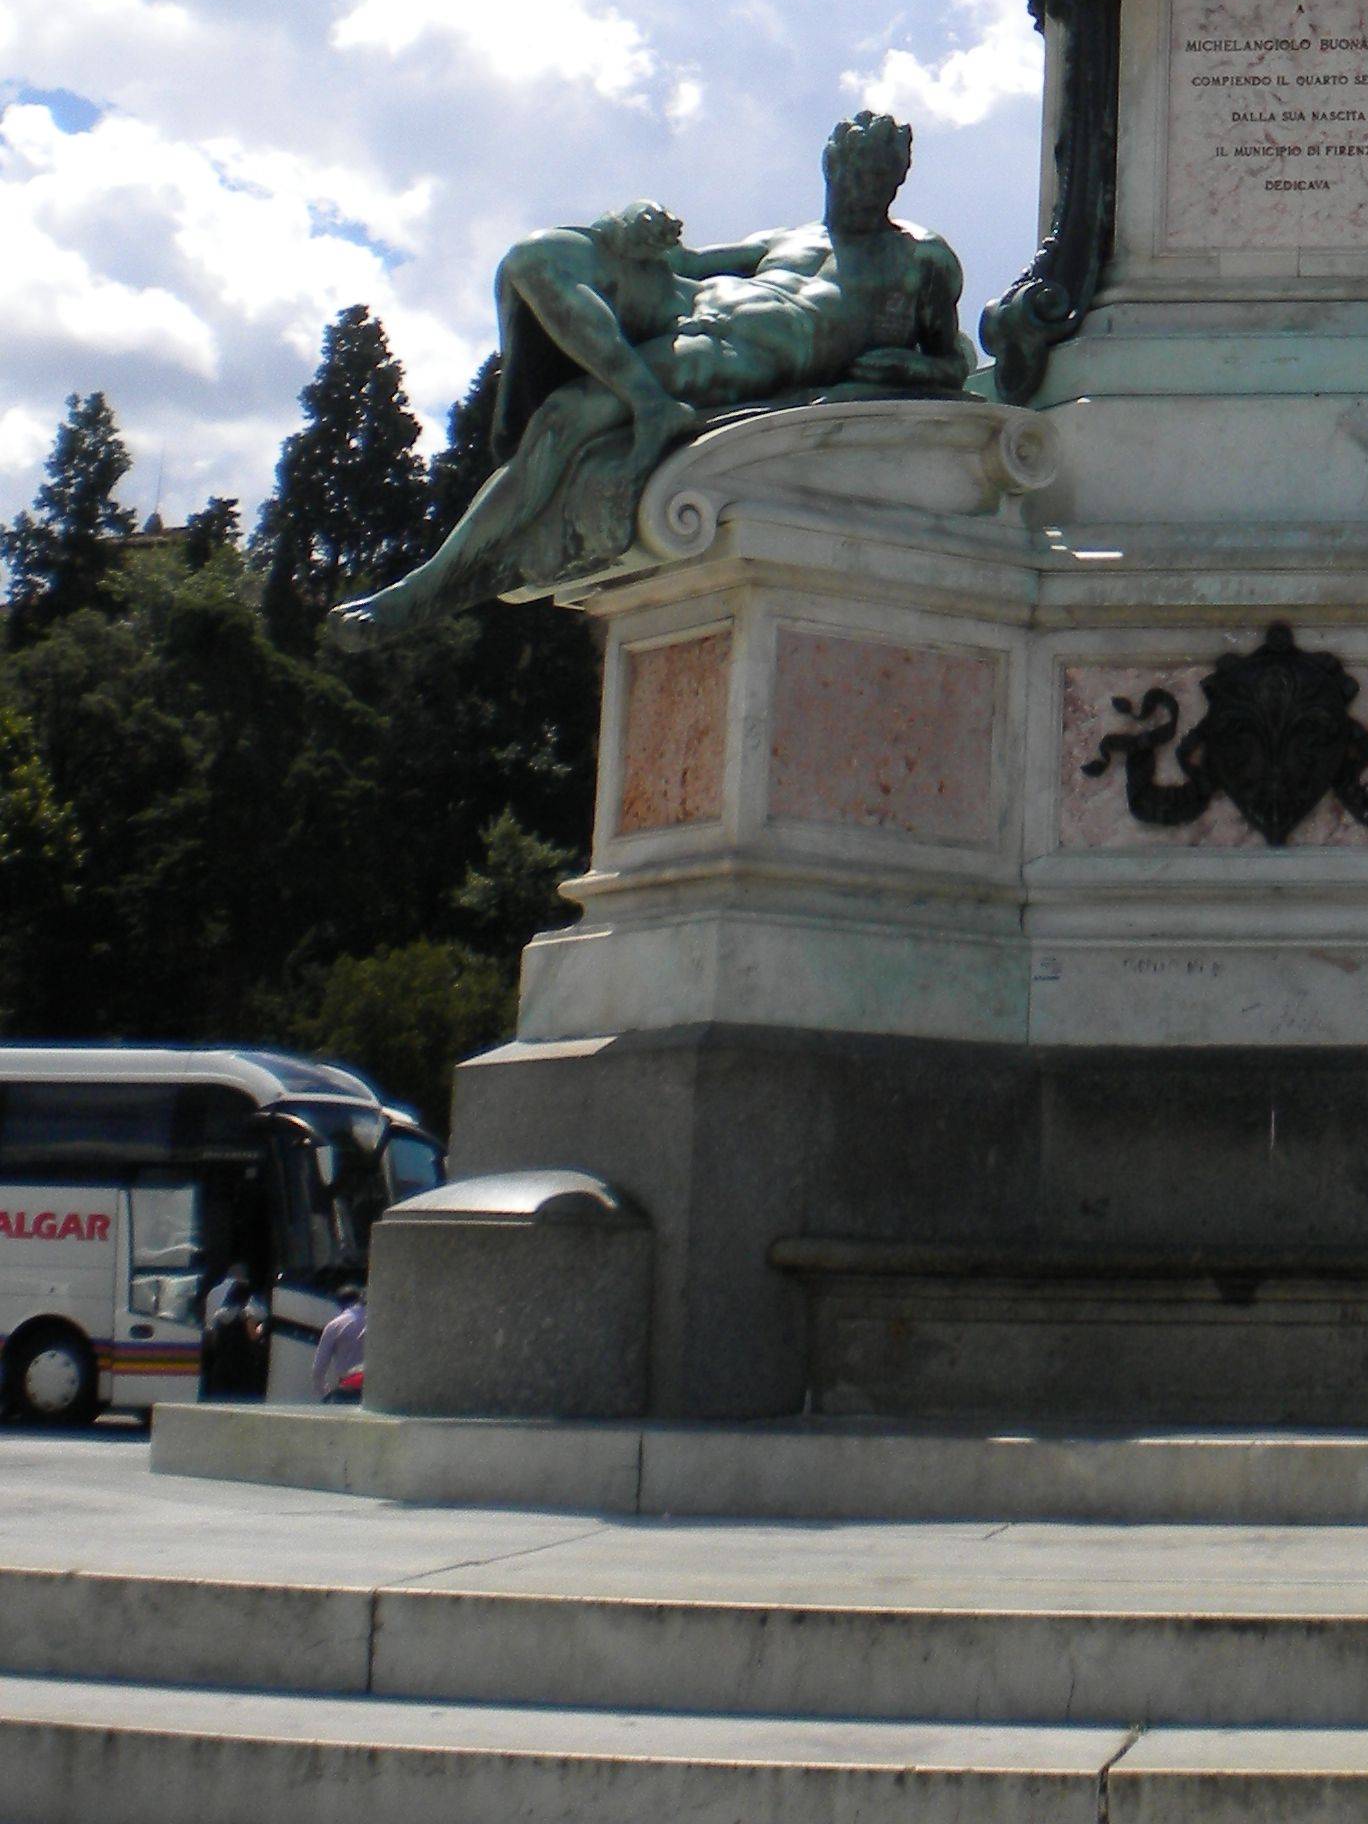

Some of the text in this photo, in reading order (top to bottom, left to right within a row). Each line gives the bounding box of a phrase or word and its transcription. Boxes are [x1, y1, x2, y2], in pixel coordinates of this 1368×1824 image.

[1296, 4, 1304, 14] A
[1185, 39, 1311, 52] MICHELANGIOLO
[1191, 75, 1272, 87] COMPIENDO
[1276, 75, 1289, 86] IL
[1296, 75, 1349, 86] QUARTO
[1232, 111, 1366, 122] DALLA SUA NASCITA
[1215, 146, 1228, 157] IL
[1234, 146, 1302, 157] MUNICIPIO
[1307, 145, 1320, 156] DI
[1265, 180, 1331, 191] DEDICAVA
